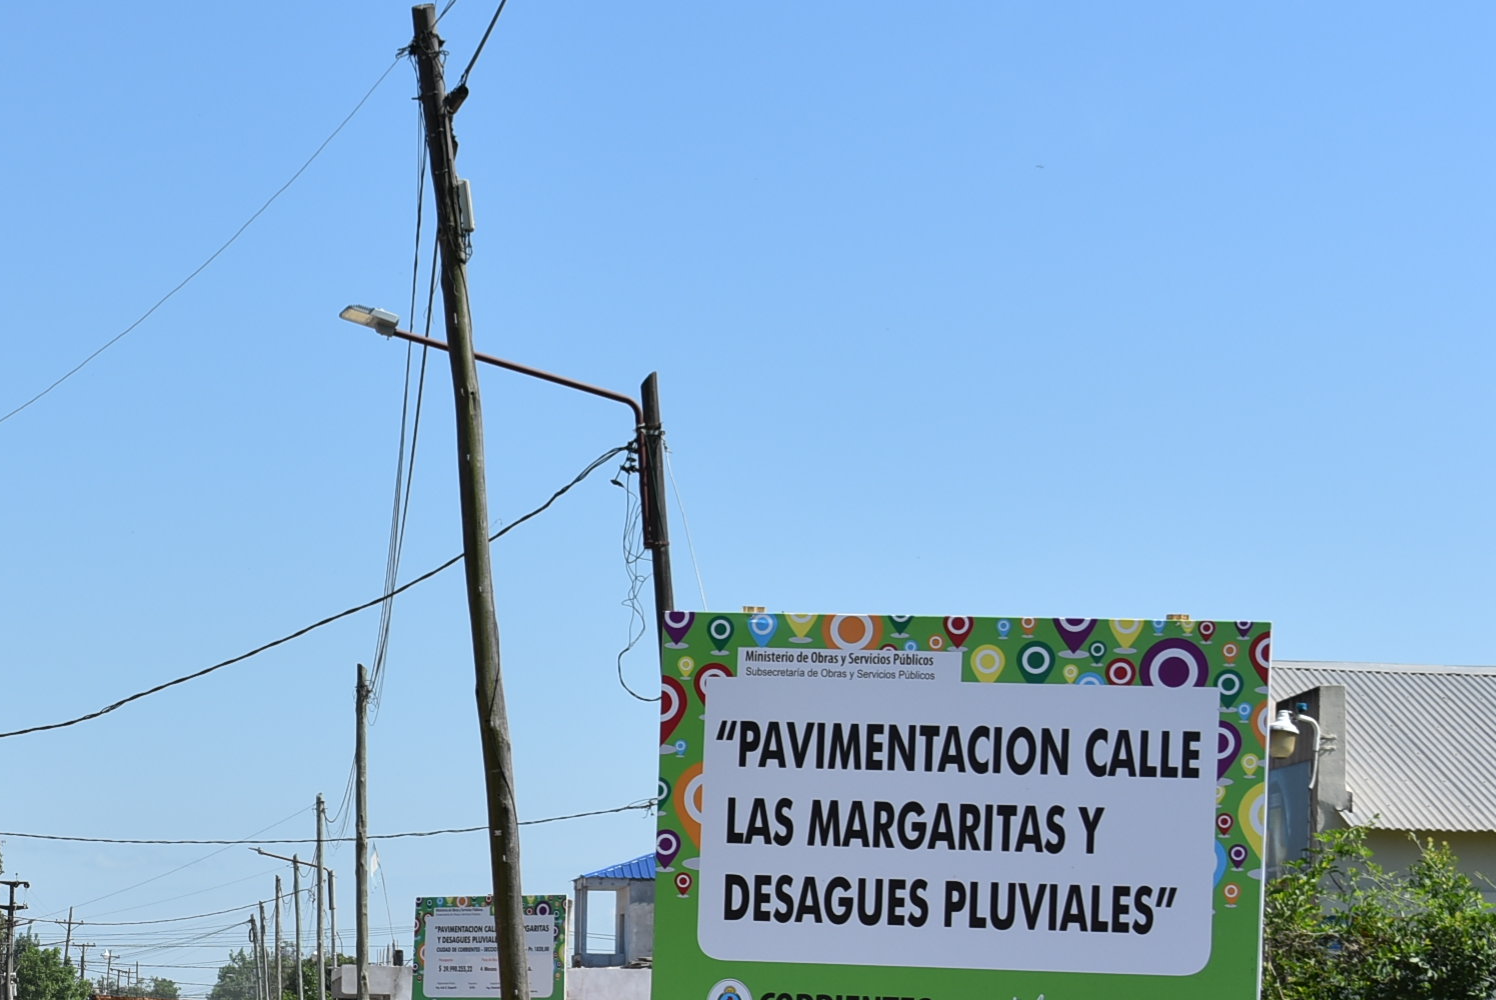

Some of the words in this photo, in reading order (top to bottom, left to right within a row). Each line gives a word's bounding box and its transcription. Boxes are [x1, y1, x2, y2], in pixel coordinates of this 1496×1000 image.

[745, 650, 795, 663] Ministerio
[796, 651, 809, 663] de
[811, 651, 839, 664] Obras
[840, 655, 847, 667] y
[848, 652, 891, 665] Servicios
[893, 653, 934, 666] Públicos
[745, 666, 805, 677] Subsecretaría
[807, 668, 819, 677] de
[820, 668, 847, 679] Obras
[849, 671, 855, 681] y
[857, 669, 896, 680] Servicios
[898, 670, 936, 681] Públicos
[716, 720, 1070, 776] “PAVIMENTACION
[1084, 727, 1202, 779] CALLE
[726, 797, 795, 847] LAS
[807, 799, 1066, 855] MARGARITAS
[1078, 807, 1106, 855] Y
[723, 873, 930, 928] DESAGUES
[944, 880, 1178, 936] PLUVIALES”
[523, 924, 550, 932] GARITAS
[437, 936, 442, 944] Y
[442, 936, 471, 944] DESAGUES
